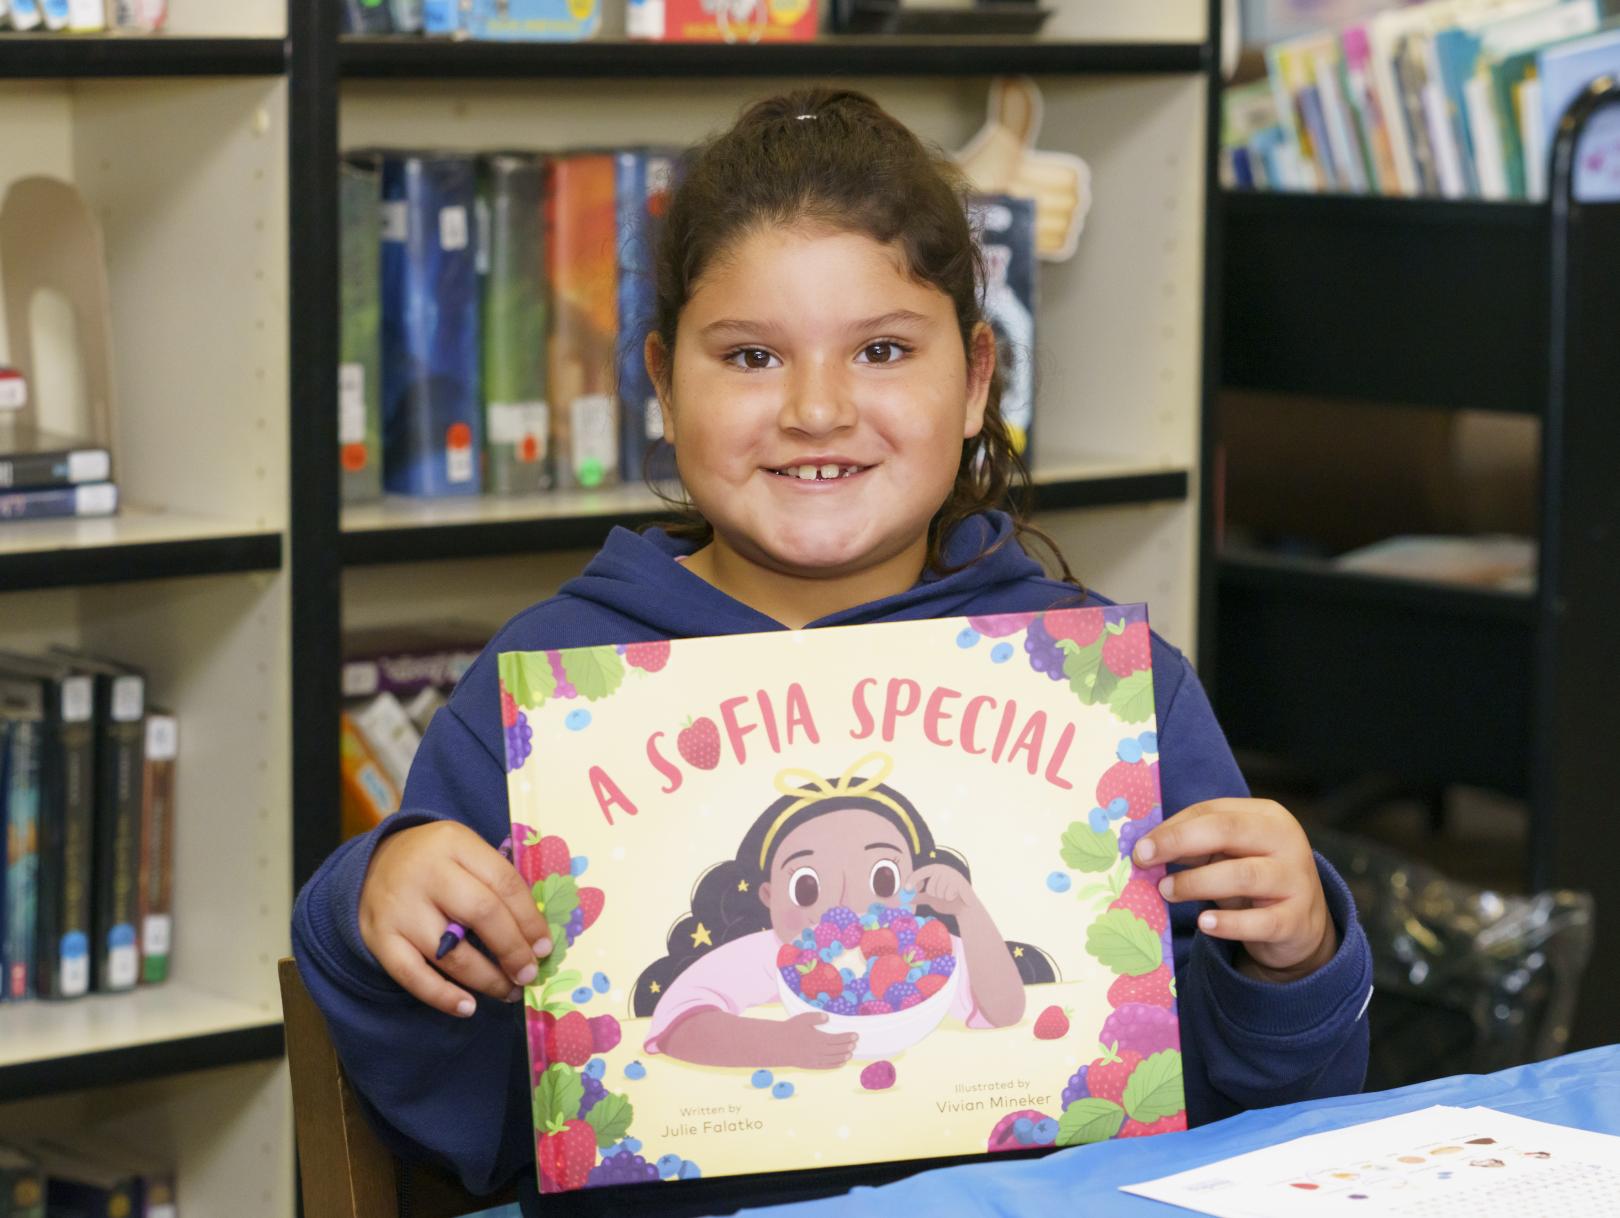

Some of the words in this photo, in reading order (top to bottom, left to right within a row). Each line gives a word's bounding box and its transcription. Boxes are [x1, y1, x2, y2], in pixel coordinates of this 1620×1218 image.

[588, 765, 638, 826] A
[849, 677, 1076, 790] SPECIAL
[954, 1080, 1014, 1093] Illustrated
[1017, 1079, 1031, 1089] by
[680, 1106, 725, 1117] Written
[728, 1104, 742, 1114] by
[936, 1100, 985, 1113] Vivian
[990, 1094, 1052, 1108] Mineker
[661, 1124, 698, 1138] Julie
[703, 1118, 764, 1134] Falatko
